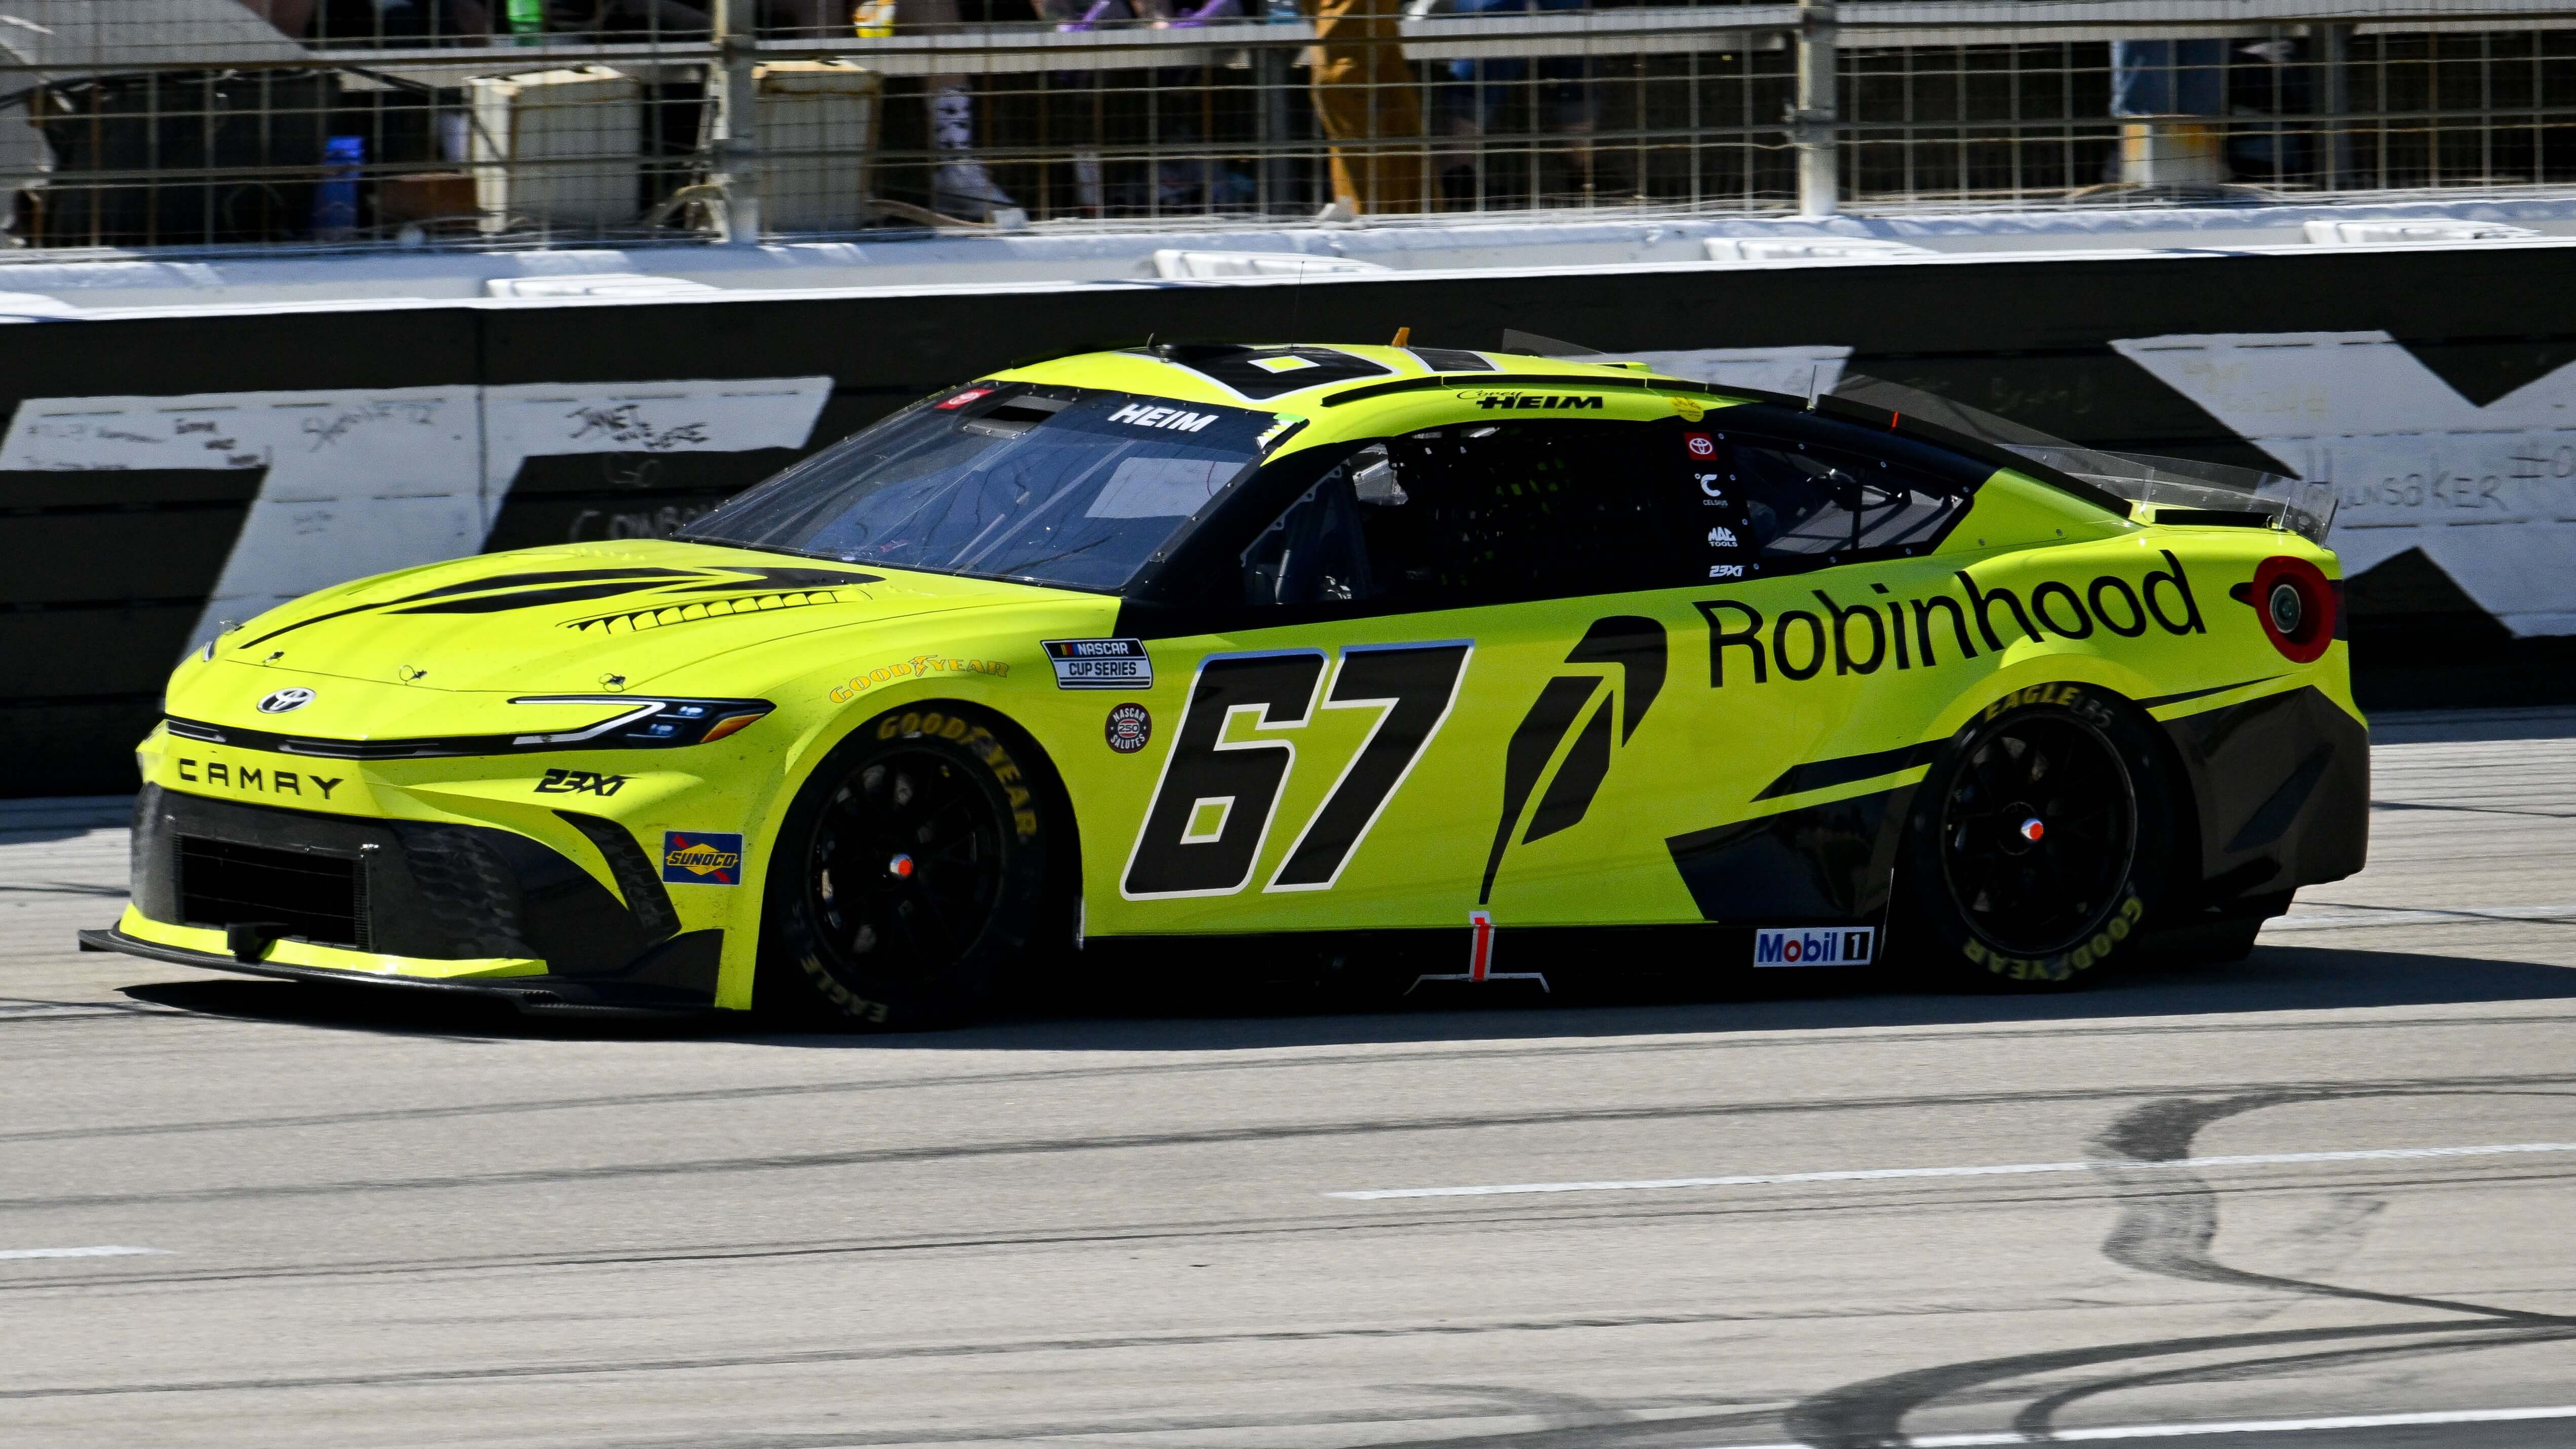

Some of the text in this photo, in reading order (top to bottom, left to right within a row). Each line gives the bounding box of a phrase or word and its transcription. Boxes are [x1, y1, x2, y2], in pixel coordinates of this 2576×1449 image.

[1476, 396, 1603, 409] HEIM
[1108, 404, 1219, 432] HEIM
[1708, 527, 1736, 541] MAC
[1693, 549, 2207, 688] Robinhood
[1077, 642, 1129, 655] NASCAR
[829, 654, 1011, 703] GOODYEAR
[1069, 661, 1137, 676] CUP SERIES
[1984, 684, 2080, 722] EAGLE
[1112, 708, 1146, 722] NASCAR
[1118, 724, 1139, 732] 250
[1110, 733, 1145, 749] SALUTES
[179, 758, 344, 800] CAMRY
[877, 712, 1037, 836] GOODYEAR
[1119, 639, 1475, 901] 67
[667, 851, 738, 867] SUNOCO
[1758, 932, 1838, 962] Mobil
